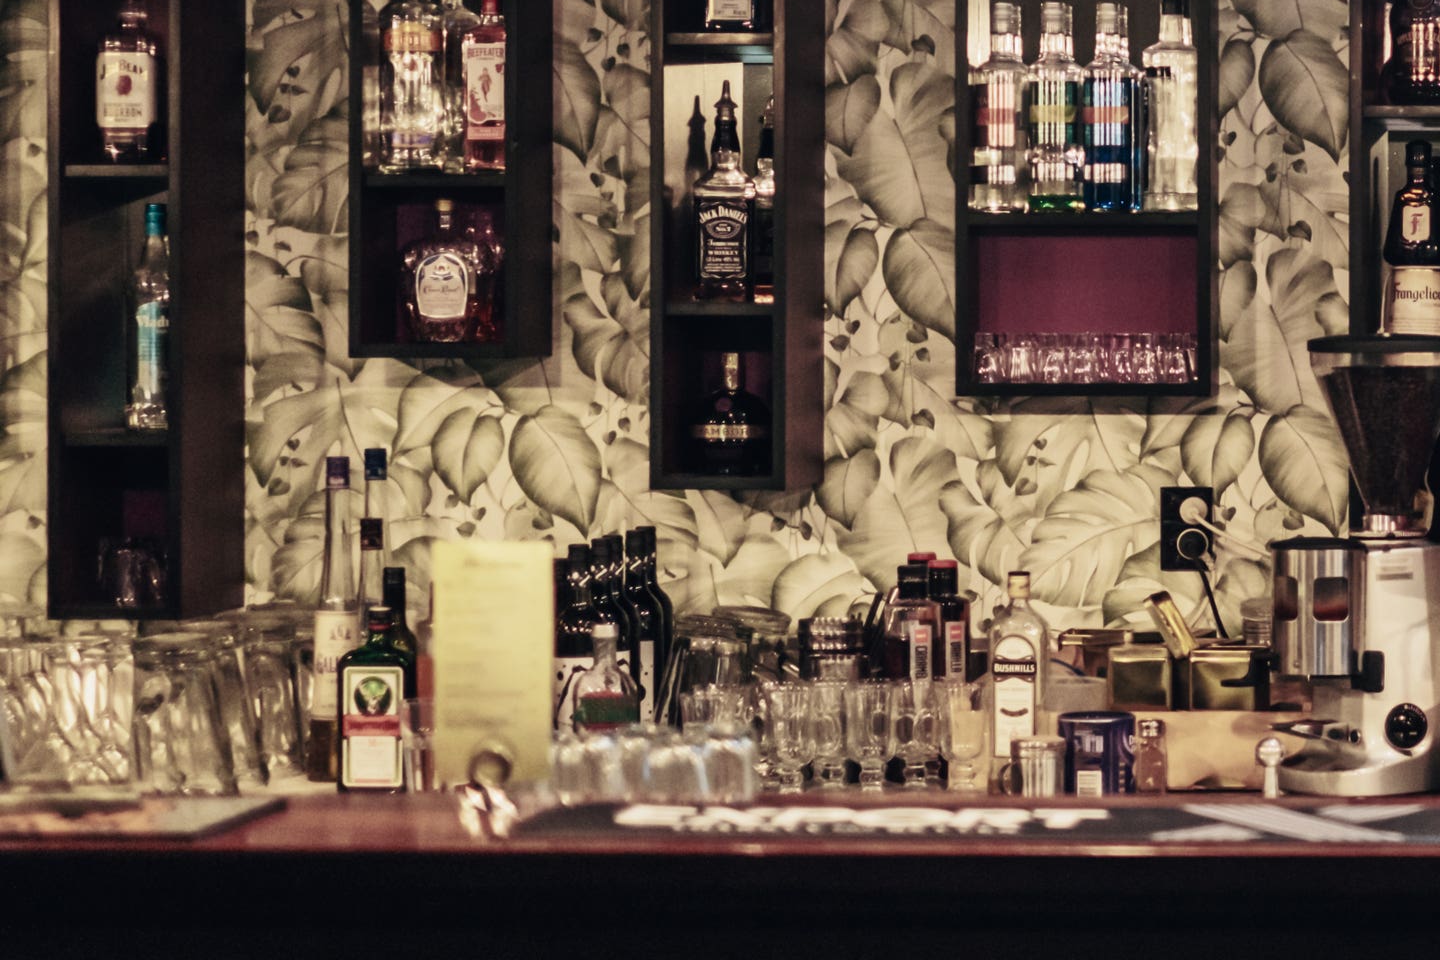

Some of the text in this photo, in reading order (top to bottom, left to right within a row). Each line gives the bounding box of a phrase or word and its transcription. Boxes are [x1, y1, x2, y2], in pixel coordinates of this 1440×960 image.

[467, 47, 504, 59] BEEFEATER
[699, 209, 718, 225] JACK
[993, 663, 1036, 674] BUSHMILLS
